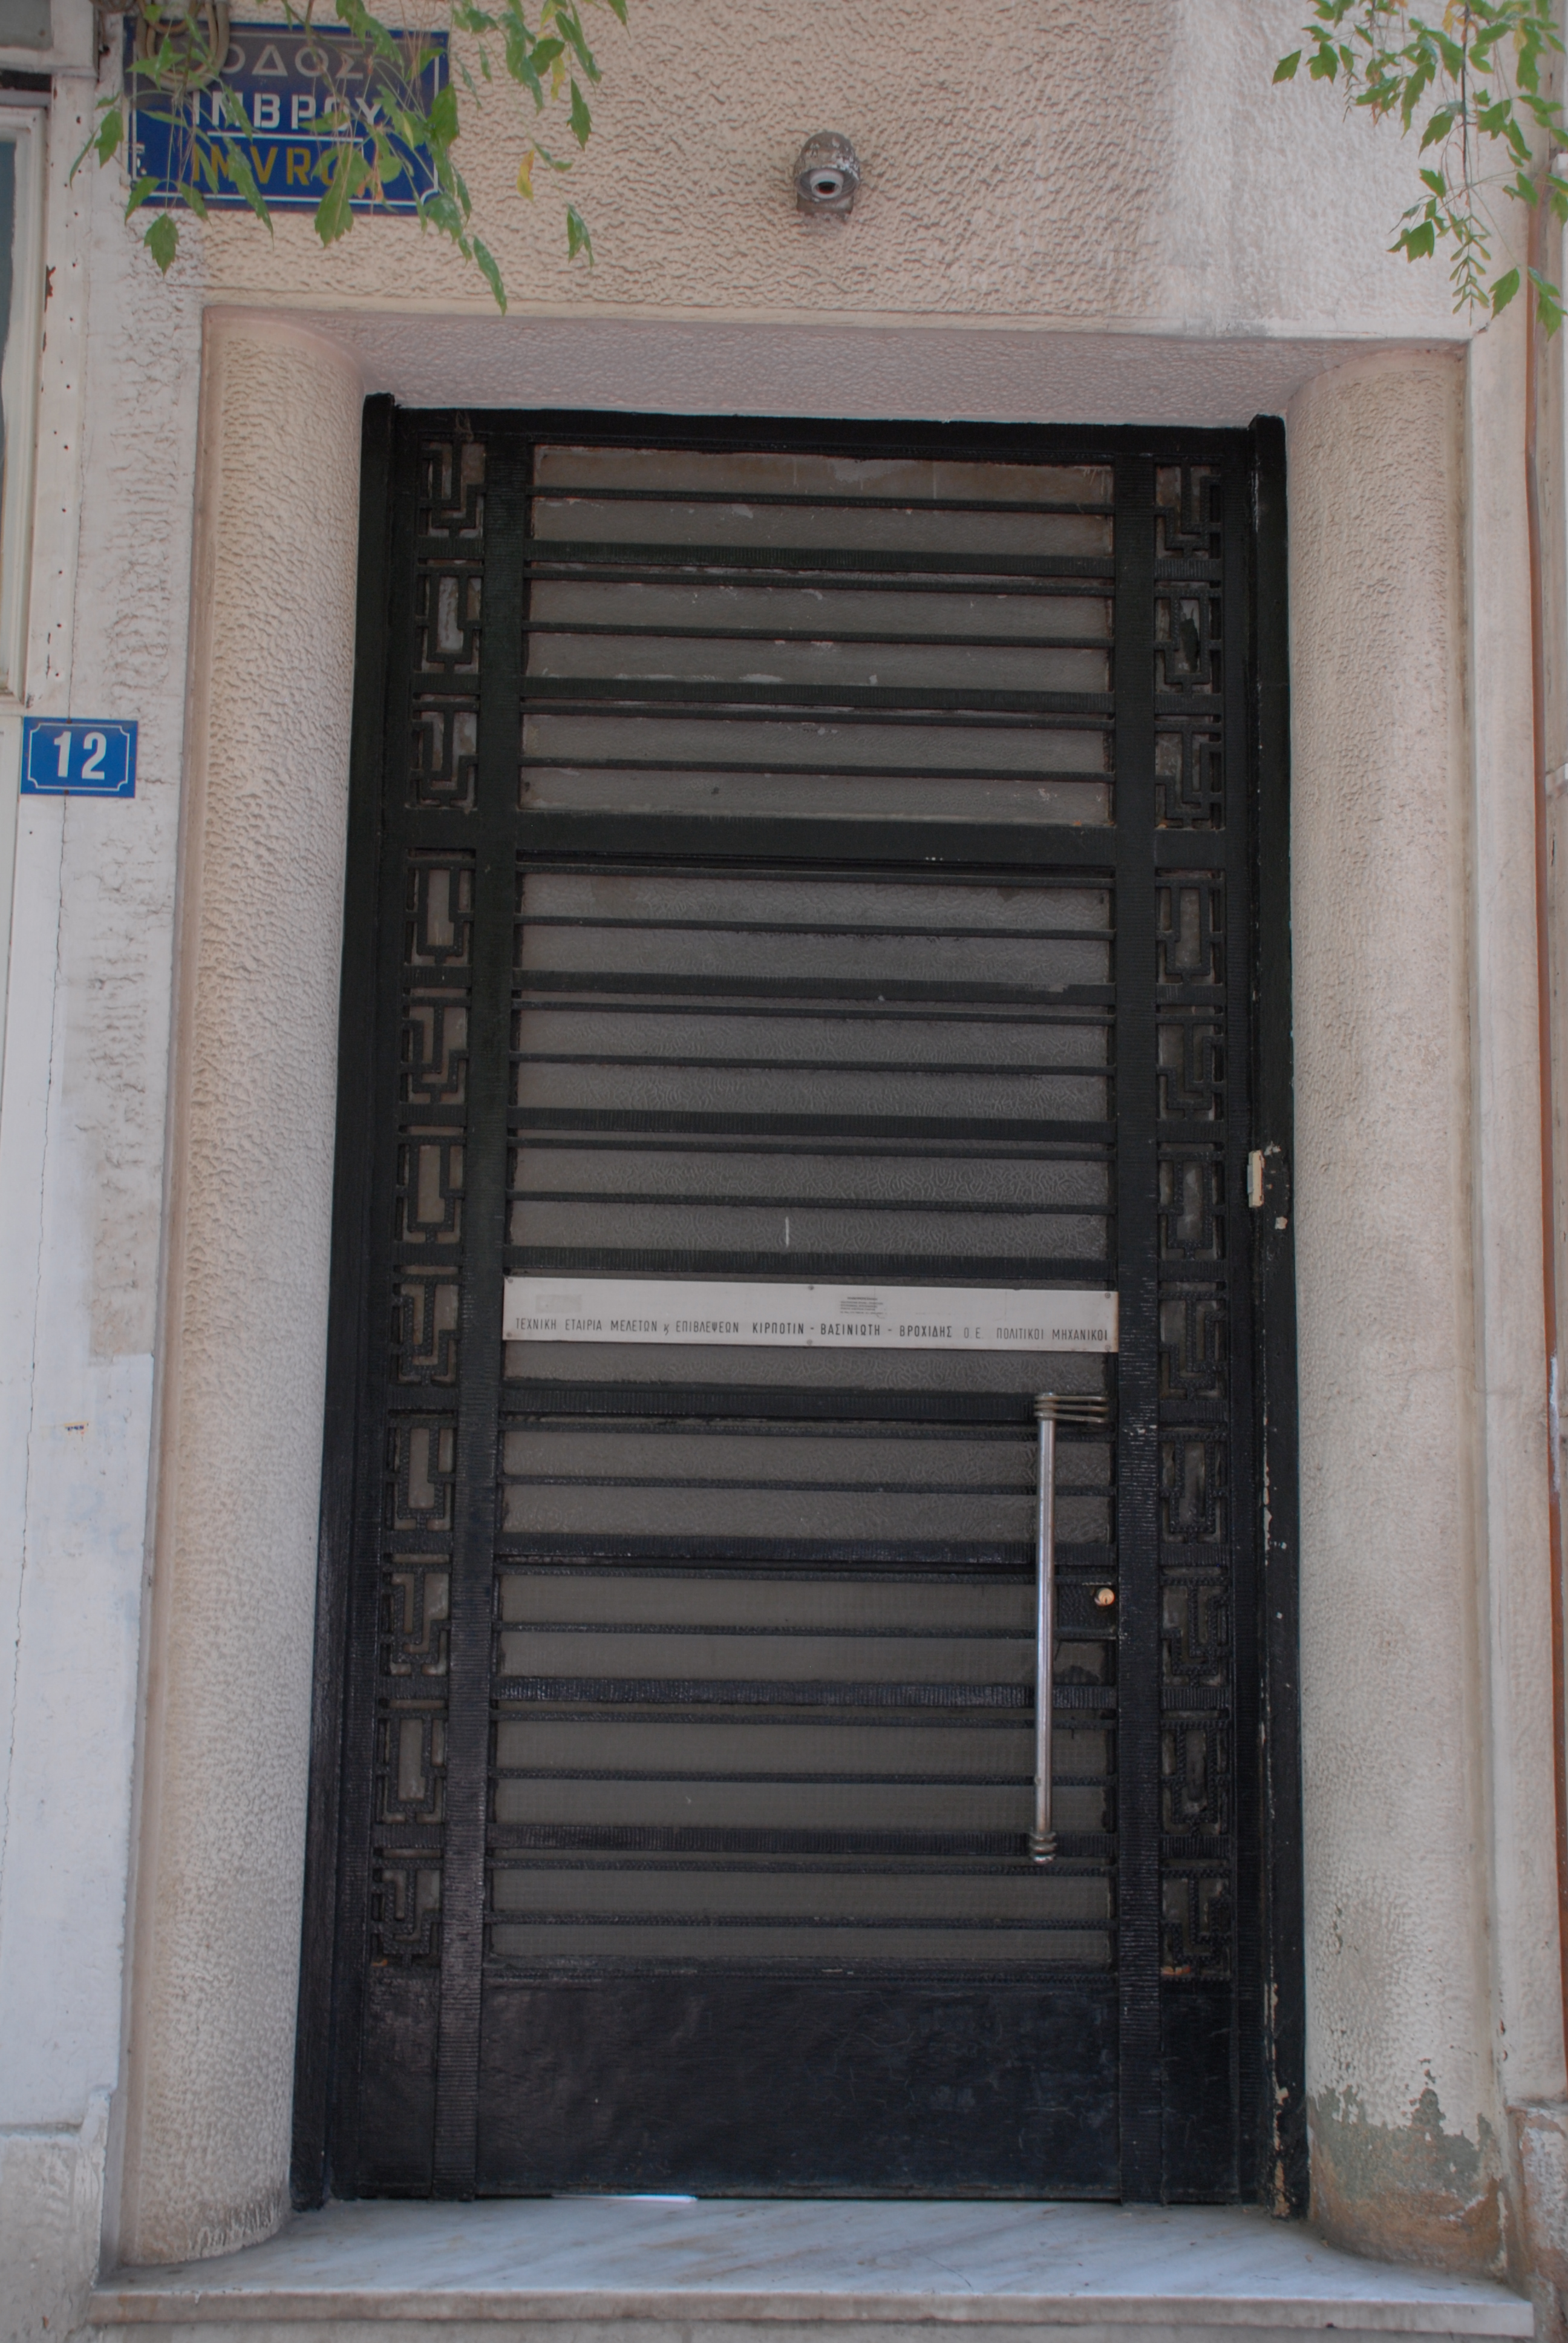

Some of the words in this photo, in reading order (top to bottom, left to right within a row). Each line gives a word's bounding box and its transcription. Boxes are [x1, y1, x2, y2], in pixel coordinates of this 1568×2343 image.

[54, 731, 106, 780] 12
[515, 1317, 557, 1330] ΤΕΧΝΙΚΗ
[565, 1319, 603, 1331] ΕΤΑΙΡΙΑ
[610, 1320, 658, 1332] ΜΕΛΕΤΩΝ
[676, 1320, 739, 1333] ΕΠΙΒΛΕΨΕΩΝ
[752, 1322, 805, 1335] ΚΙΡΠΟΤΙΝ
[820, 1323, 881, 1336] ΒΑΣΙΝΙΩΤΗ
[899, 1325, 952, 1337] ΒΡΟΧΙΔΗΣ
[996, 1327, 1044, 1340] ΠΟΛΙΤΙΚΟΙ
[1052, 1328, 1108, 1342] ΜΗΧΑΝΙΚΟΙ
